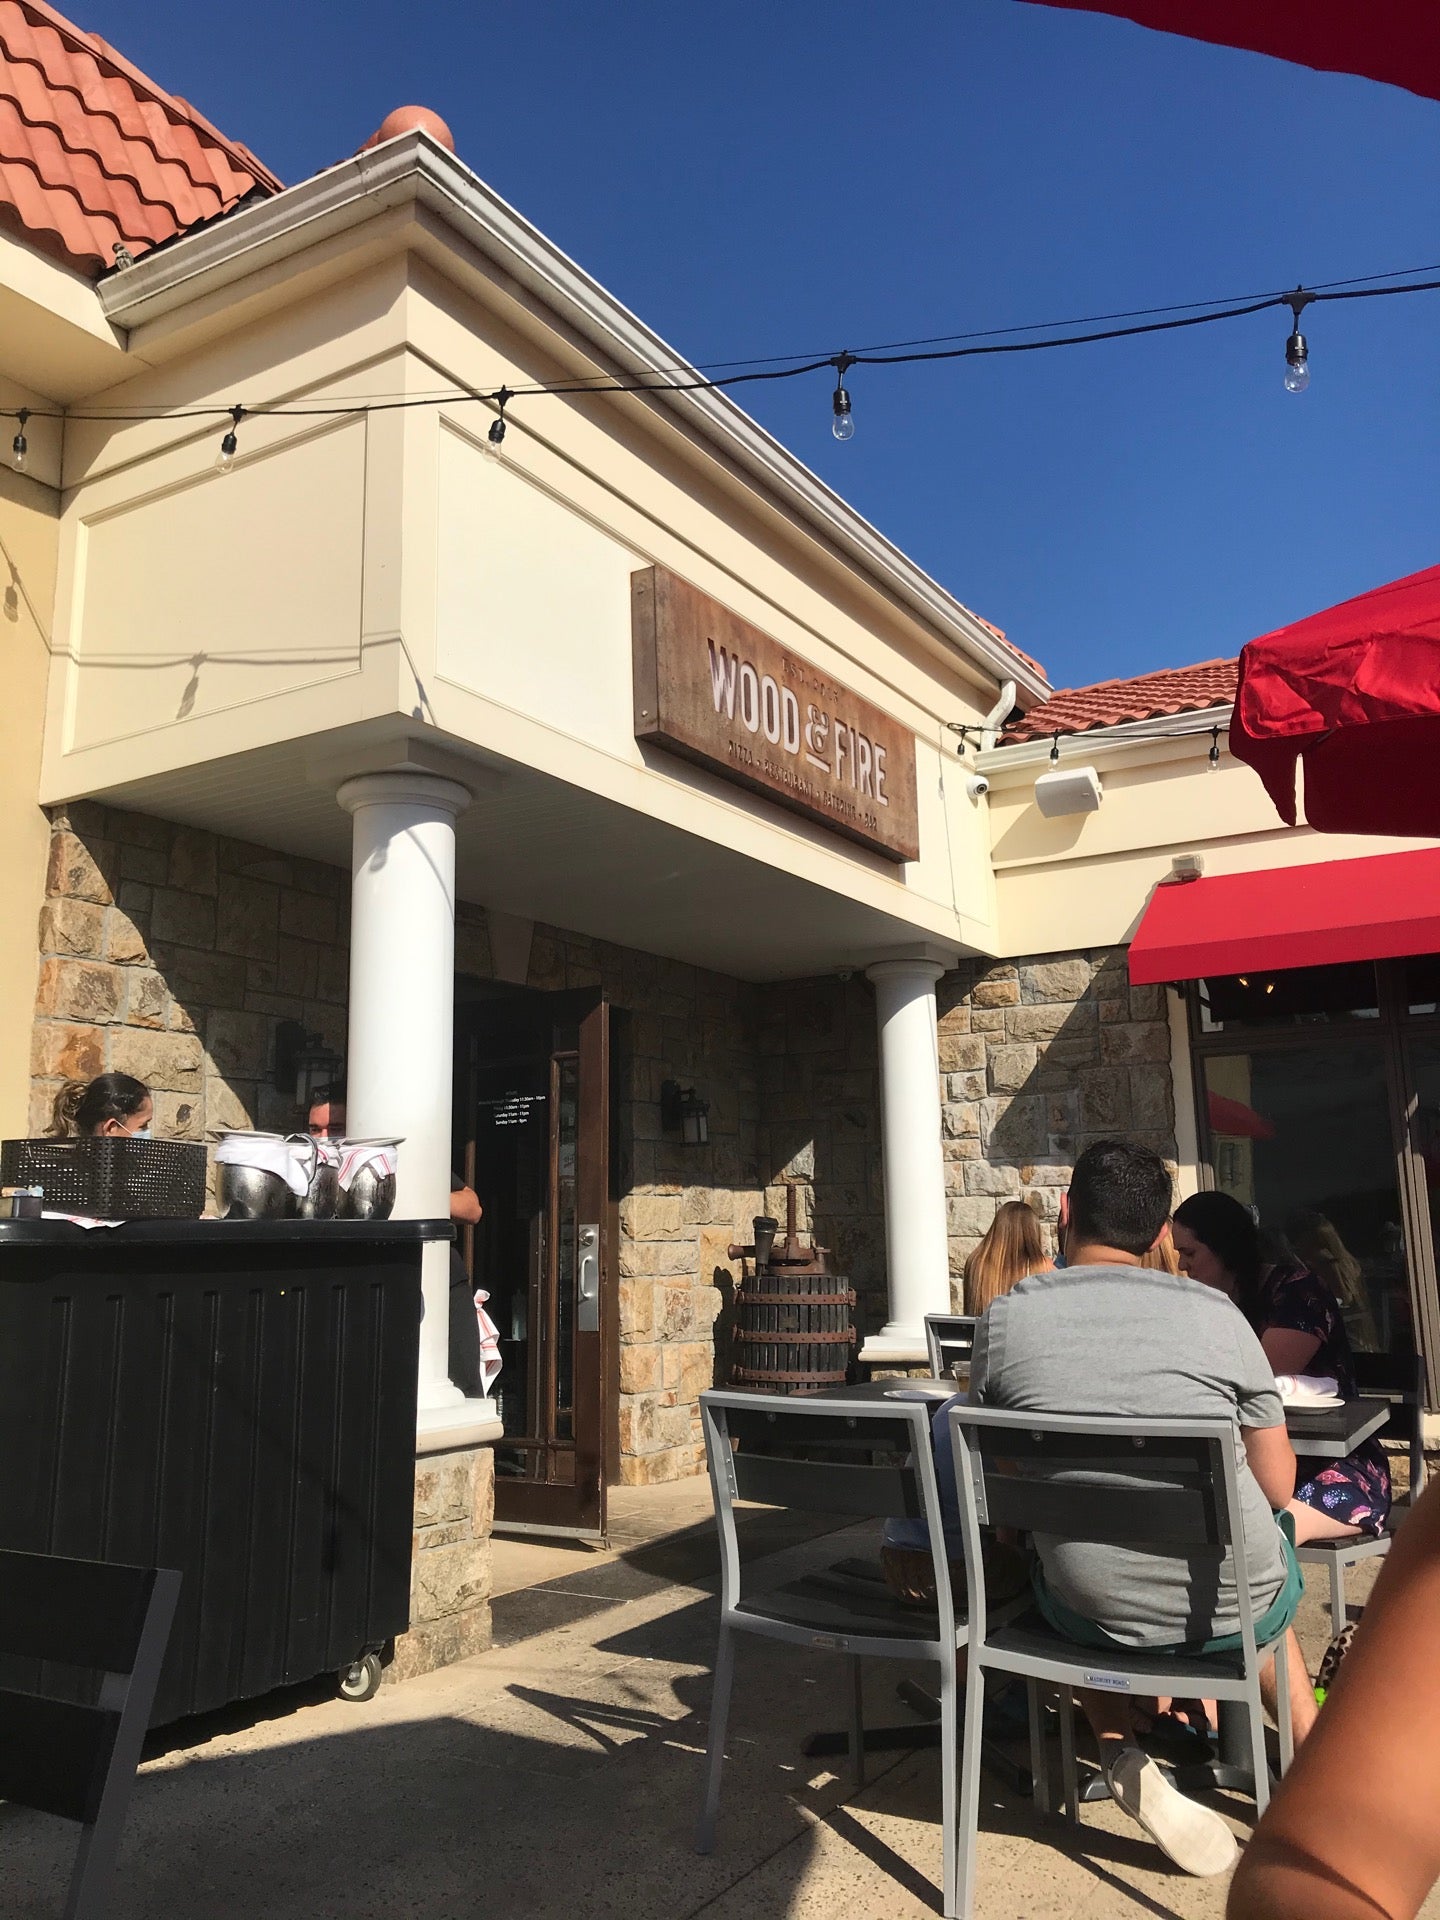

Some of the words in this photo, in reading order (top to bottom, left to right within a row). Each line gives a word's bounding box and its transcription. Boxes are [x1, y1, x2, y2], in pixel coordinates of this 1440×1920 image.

[707, 637, 800, 755] WOOD
[805, 703, 830, 754] &
[834, 717, 889, 806] FIRE
[728, 739, 753, 766] PIZZA
[763, 757, 814, 800] RESTAURANT
[823, 790, 857, 820] CATERING
[864, 812, 878, 833] BAR
